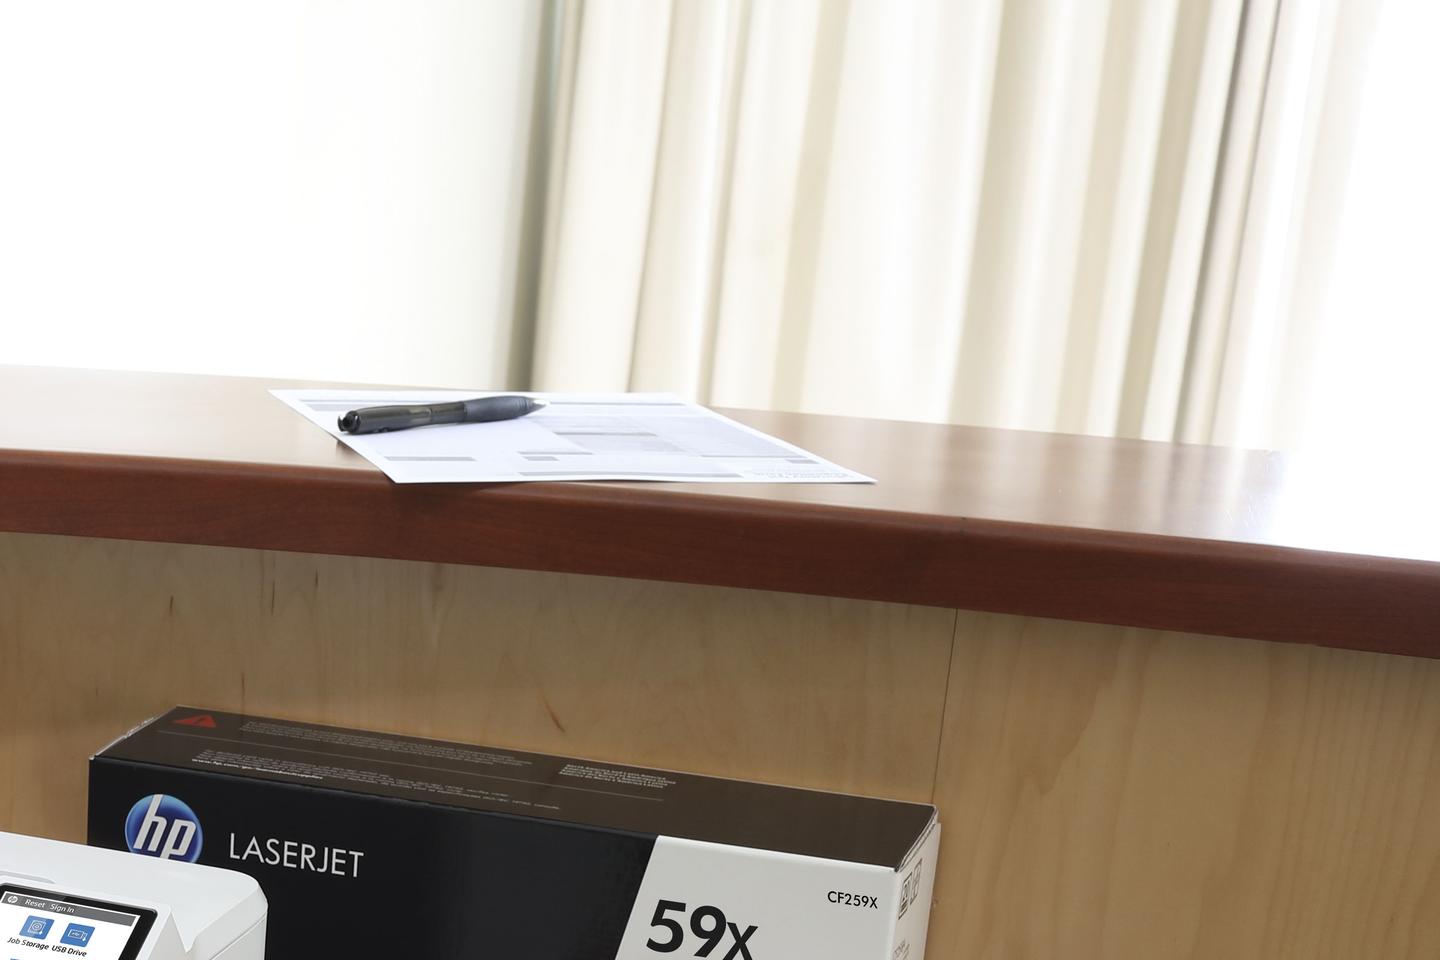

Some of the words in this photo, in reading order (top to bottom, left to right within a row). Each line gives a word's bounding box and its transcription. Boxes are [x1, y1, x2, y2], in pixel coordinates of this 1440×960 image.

[229, 832, 364, 878] LASERJET
[25, 899, 46, 908] Reset
[50, 903, 65, 913] Sign
[827, 890, 878, 910] CF259X
[7, 937, 20, 945] Job
[21, 939, 49, 950] Storage
[51, 945, 67, 953] USB
[67, 947, 87, 957] Drive
